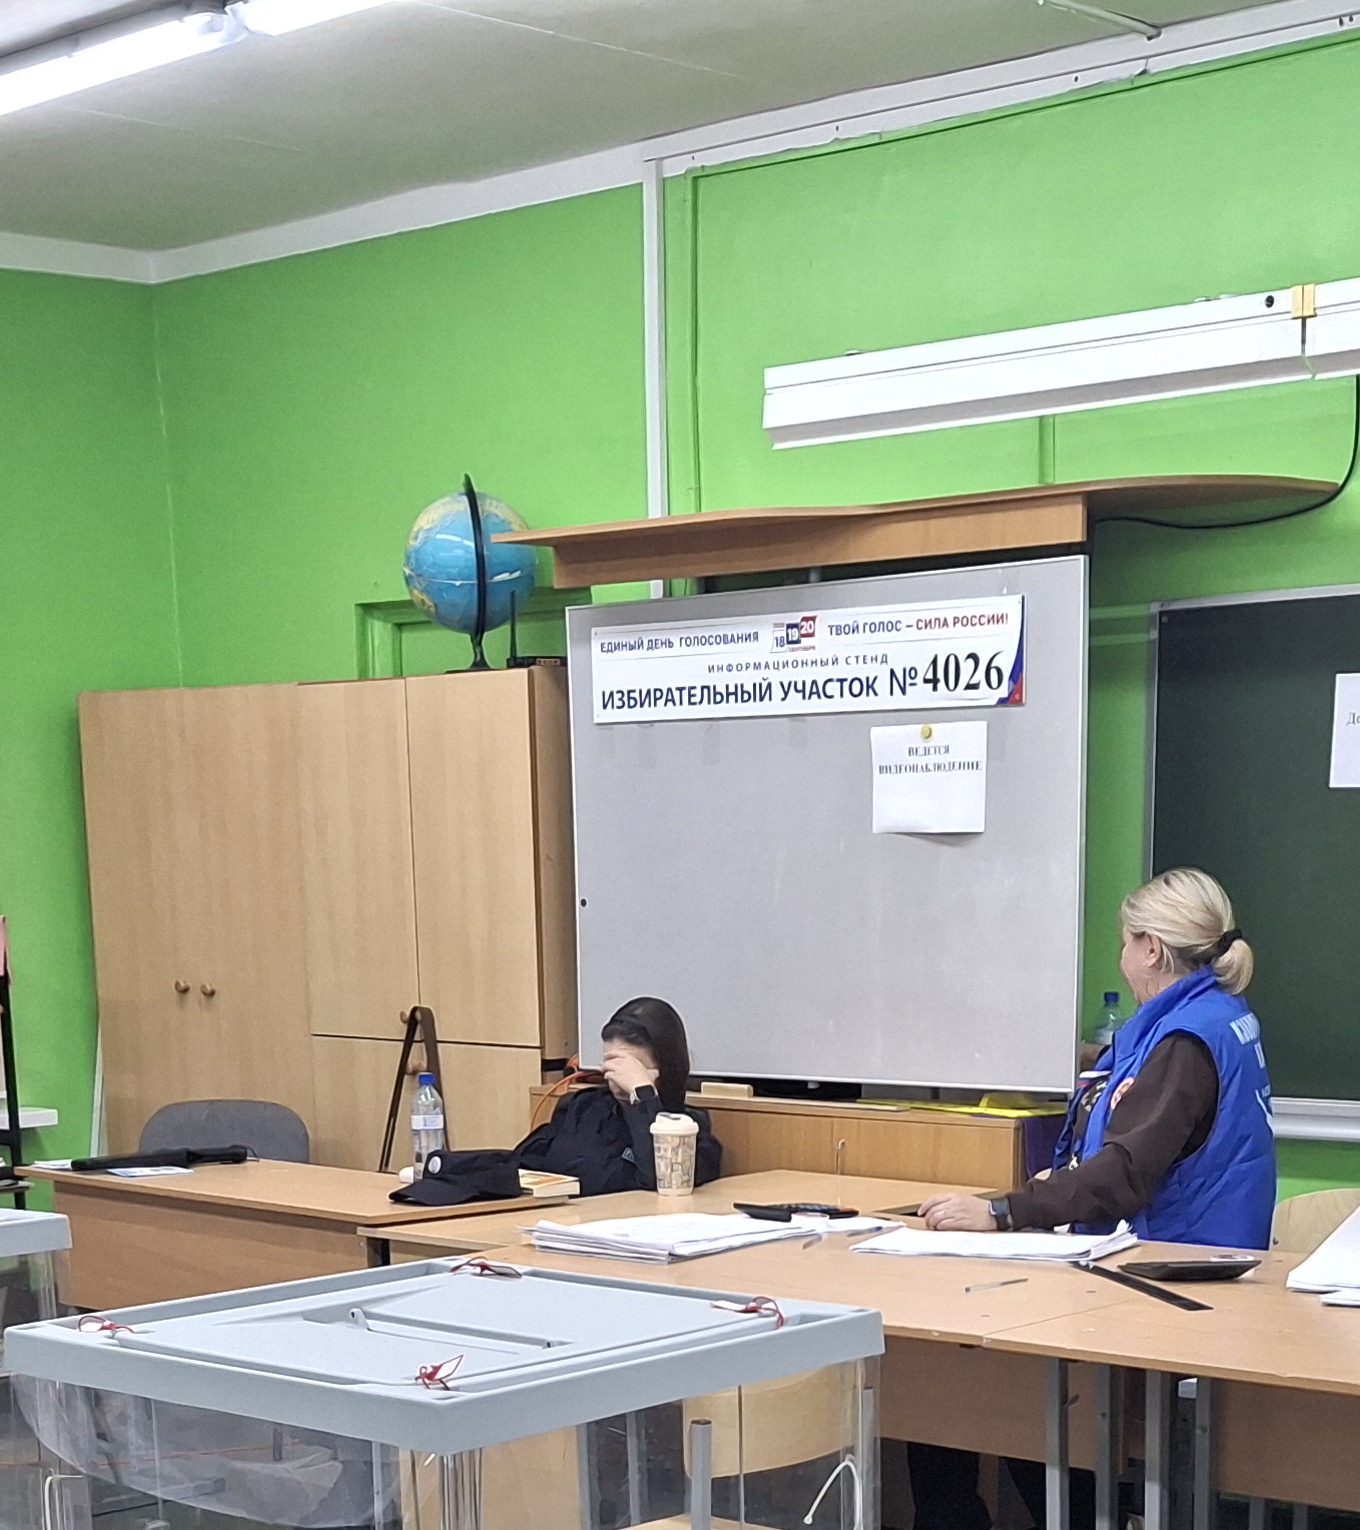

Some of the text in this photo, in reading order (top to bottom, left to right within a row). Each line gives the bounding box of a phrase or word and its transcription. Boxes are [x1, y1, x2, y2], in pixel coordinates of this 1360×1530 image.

[774, 620, 815, 648] 18 19 20
[828, 620, 859, 636] ТВОЙ
[862, 620, 903, 634] ГОЛОС
[916, 616, 949, 631] СИЛА
[953, 612, 1009, 629] РОССИИ!
[600, 631, 759, 654] ЕДИНЫЙ ДЕНЬ ГОЛОСОВАНИЯ
[707, 653, 889, 674] ИНФОРМАЦИОННЫЙ СТЕНД
[601, 677, 773, 710] ИЗБИРАТЕЛЬНЫЙ
[779, 675, 879, 702] УЧАСТОК
[922, 650, 1005, 693] 4026
[908, 745, 950, 757] ВЕДЕТСЯ
[878, 760, 982, 775] ВИДЕОНАБЛЮДЕНИЕ
